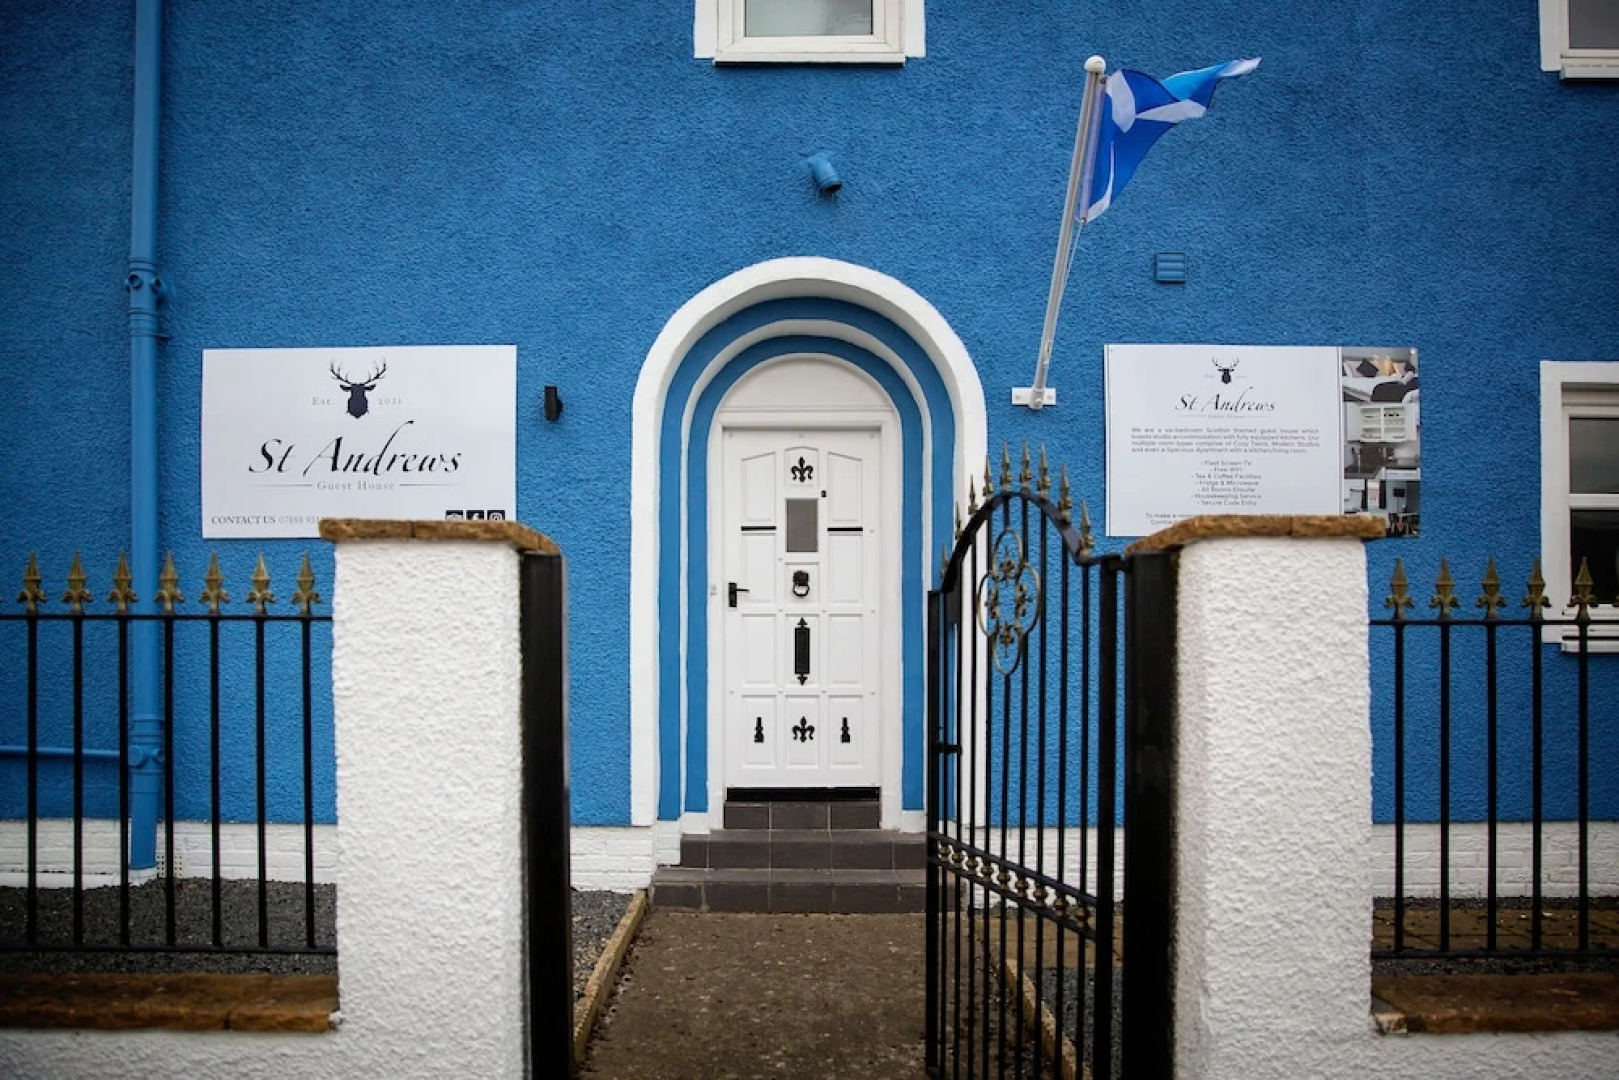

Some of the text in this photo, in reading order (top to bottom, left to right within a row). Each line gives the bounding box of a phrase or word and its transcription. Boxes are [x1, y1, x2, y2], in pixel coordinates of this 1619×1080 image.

[1174, 386, 1276, 413] St Andrews
[248, 420, 463, 477] St Andrews
[317, 480, 396, 490] Guest House
[211, 516, 260, 524] CONTACT
[263, 516, 276, 524] US
